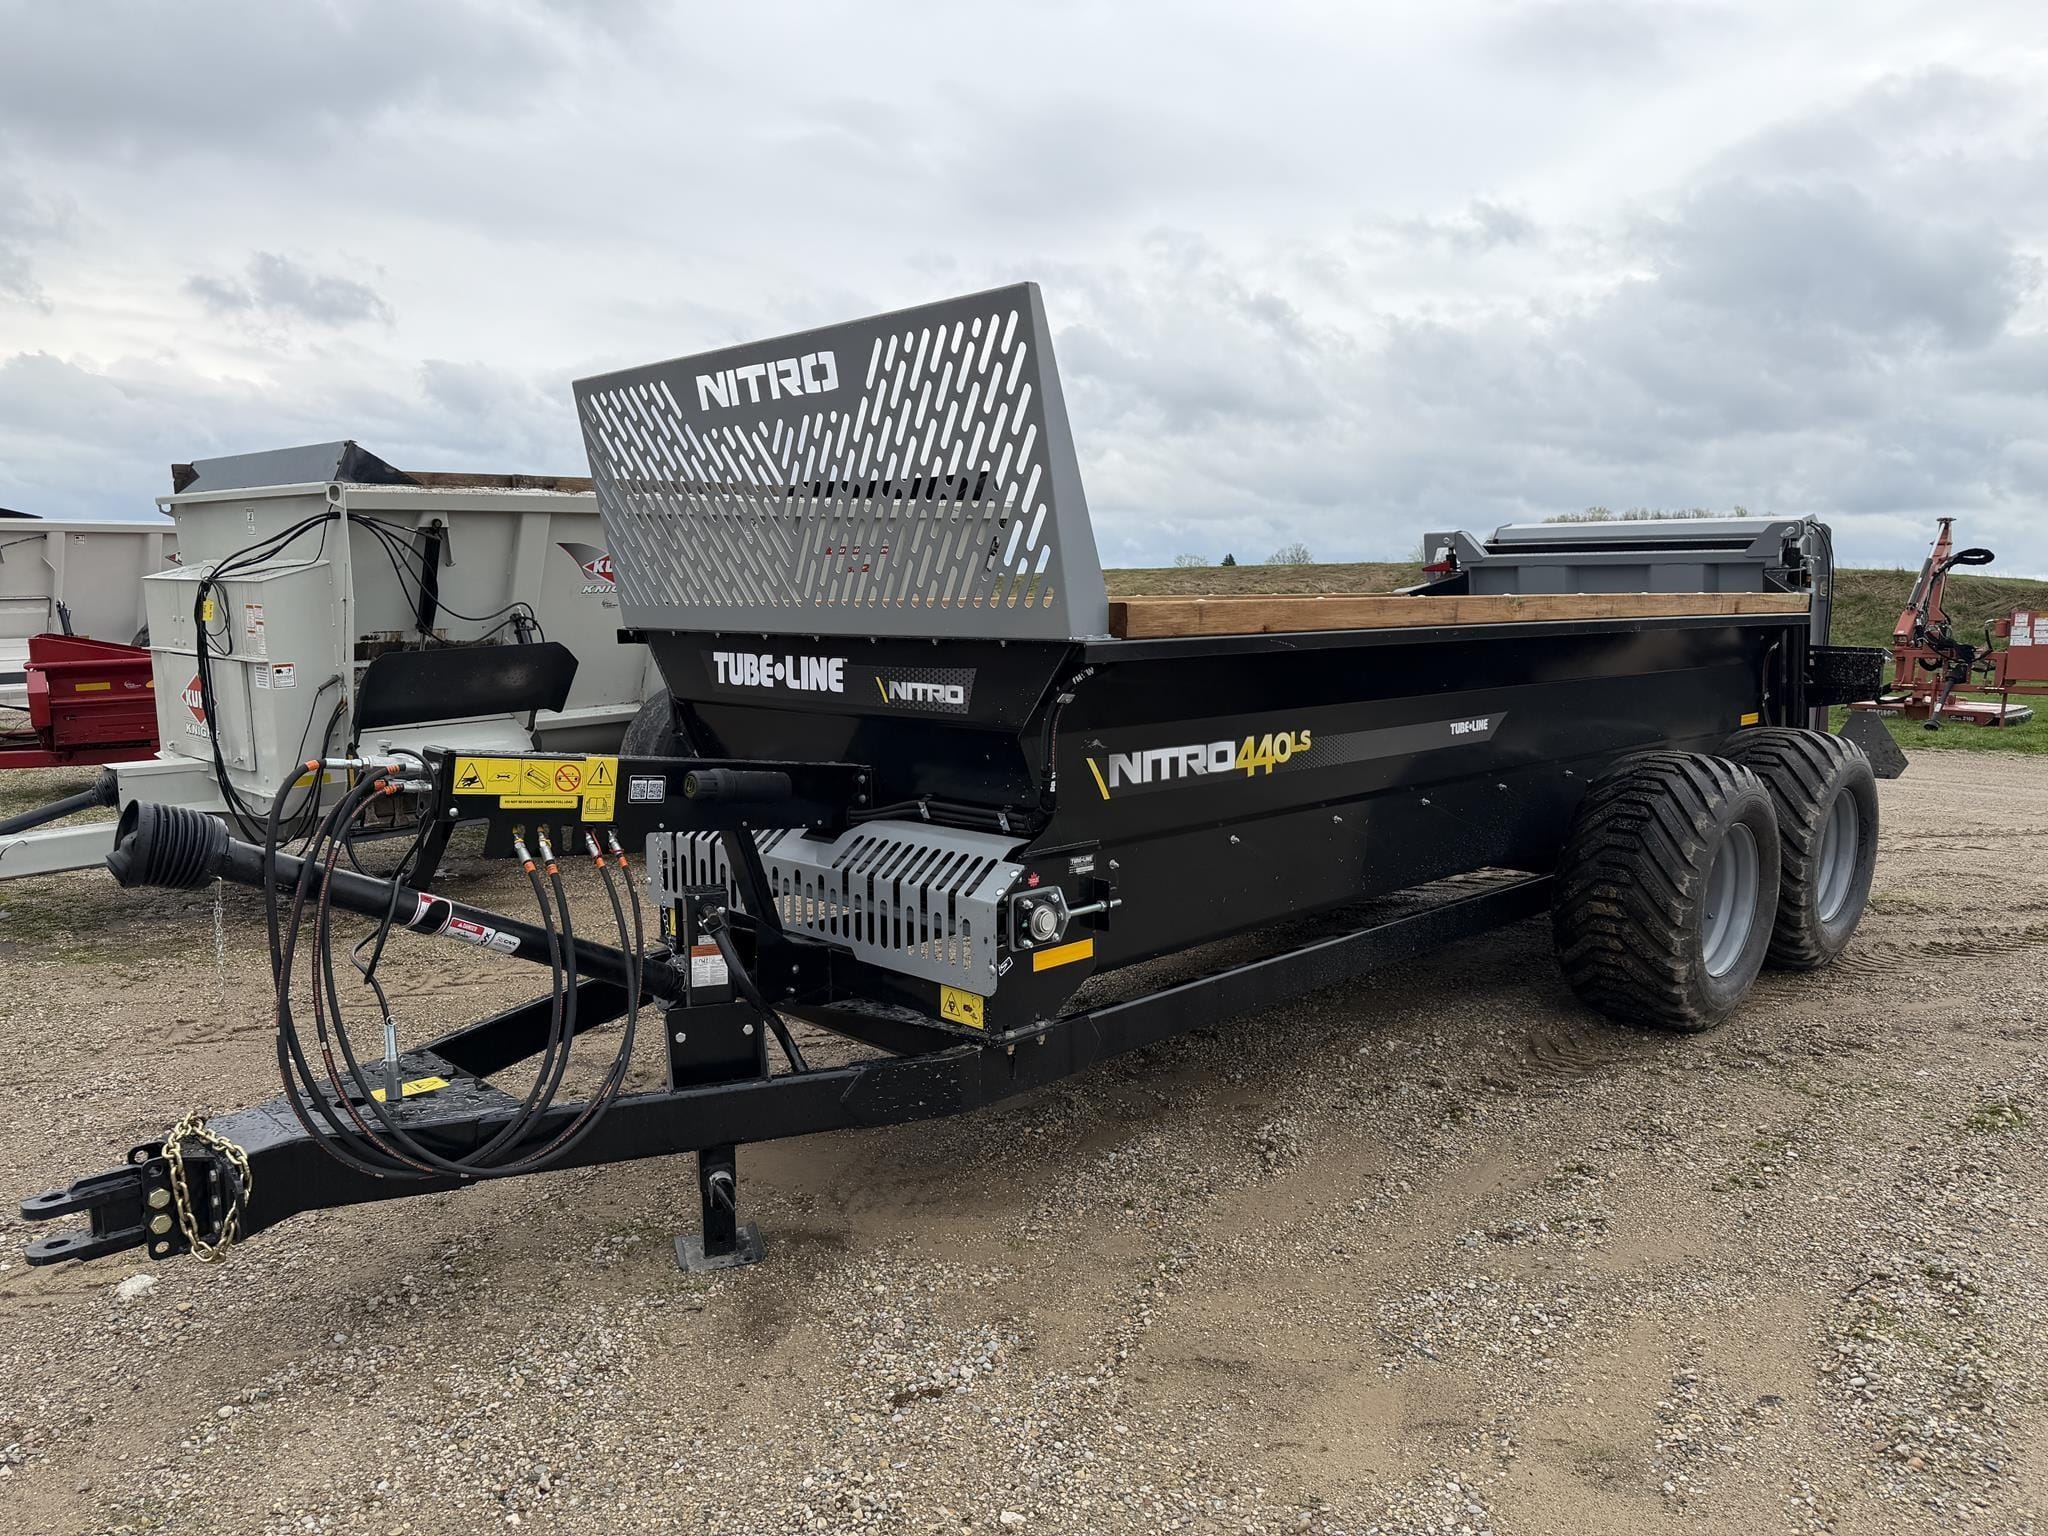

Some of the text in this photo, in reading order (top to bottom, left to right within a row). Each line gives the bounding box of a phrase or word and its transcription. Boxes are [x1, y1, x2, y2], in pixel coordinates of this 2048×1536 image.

[695, 351, 839, 411] NITRO
[888, 680, 964, 705] NITRO
[185, 723, 221, 740] KNIGT
[1109, 740, 1236, 788] NITRO
